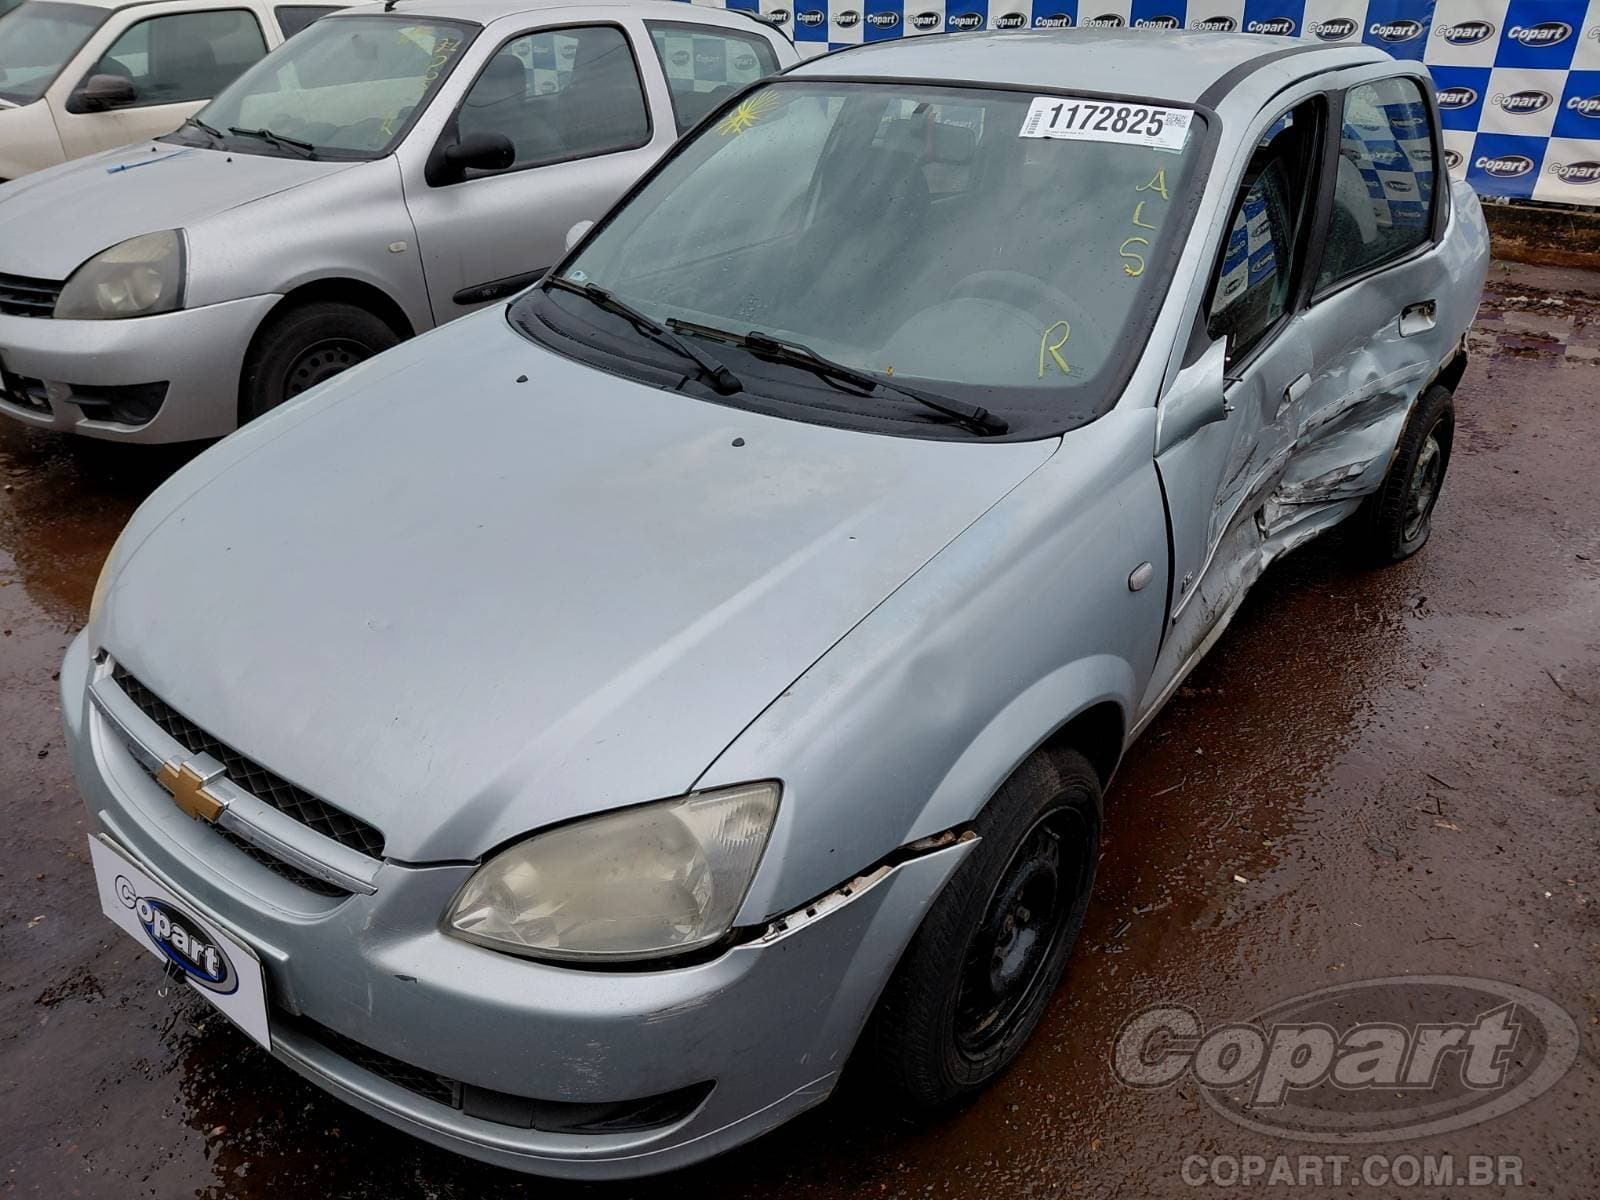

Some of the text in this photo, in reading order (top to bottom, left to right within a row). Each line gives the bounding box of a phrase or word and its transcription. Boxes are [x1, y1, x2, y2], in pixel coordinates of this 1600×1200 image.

[767, 11, 787, 24] opart
[797, 12, 821, 24] Copart
[831, 13, 857, 24] Copart
[867, 14, 895, 25] Copart
[908, 14, 937, 25] Copart
[949, 15, 979, 26] Copart
[991, 15, 1022, 27] Copart
[1035, 16, 1067, 27] Copart
[1081, 16, 1119, 27] Copart
[1135, 18, 1174, 29] Copart
[1191, 19, 1231, 31] Copart
[1248, 21, 1289, 34] Copart
[1308, 22, 1351, 36] Copart
[1369, 23, 1416, 38] Copart
[1434, 24, 1488, 39] Copart
[1508, 25, 1564, 41] Copart
[1436, 91, 1472, 104] part
[1491, 92, 1545, 109] Copart
[1566, 96, 1600, 112] Cop
[1050, 103, 1167, 137] 1172825
[1475, 156, 1528, 175] Copart
[1038, 320, 1071, 379] R
[114, 874, 219, 981] Copart
